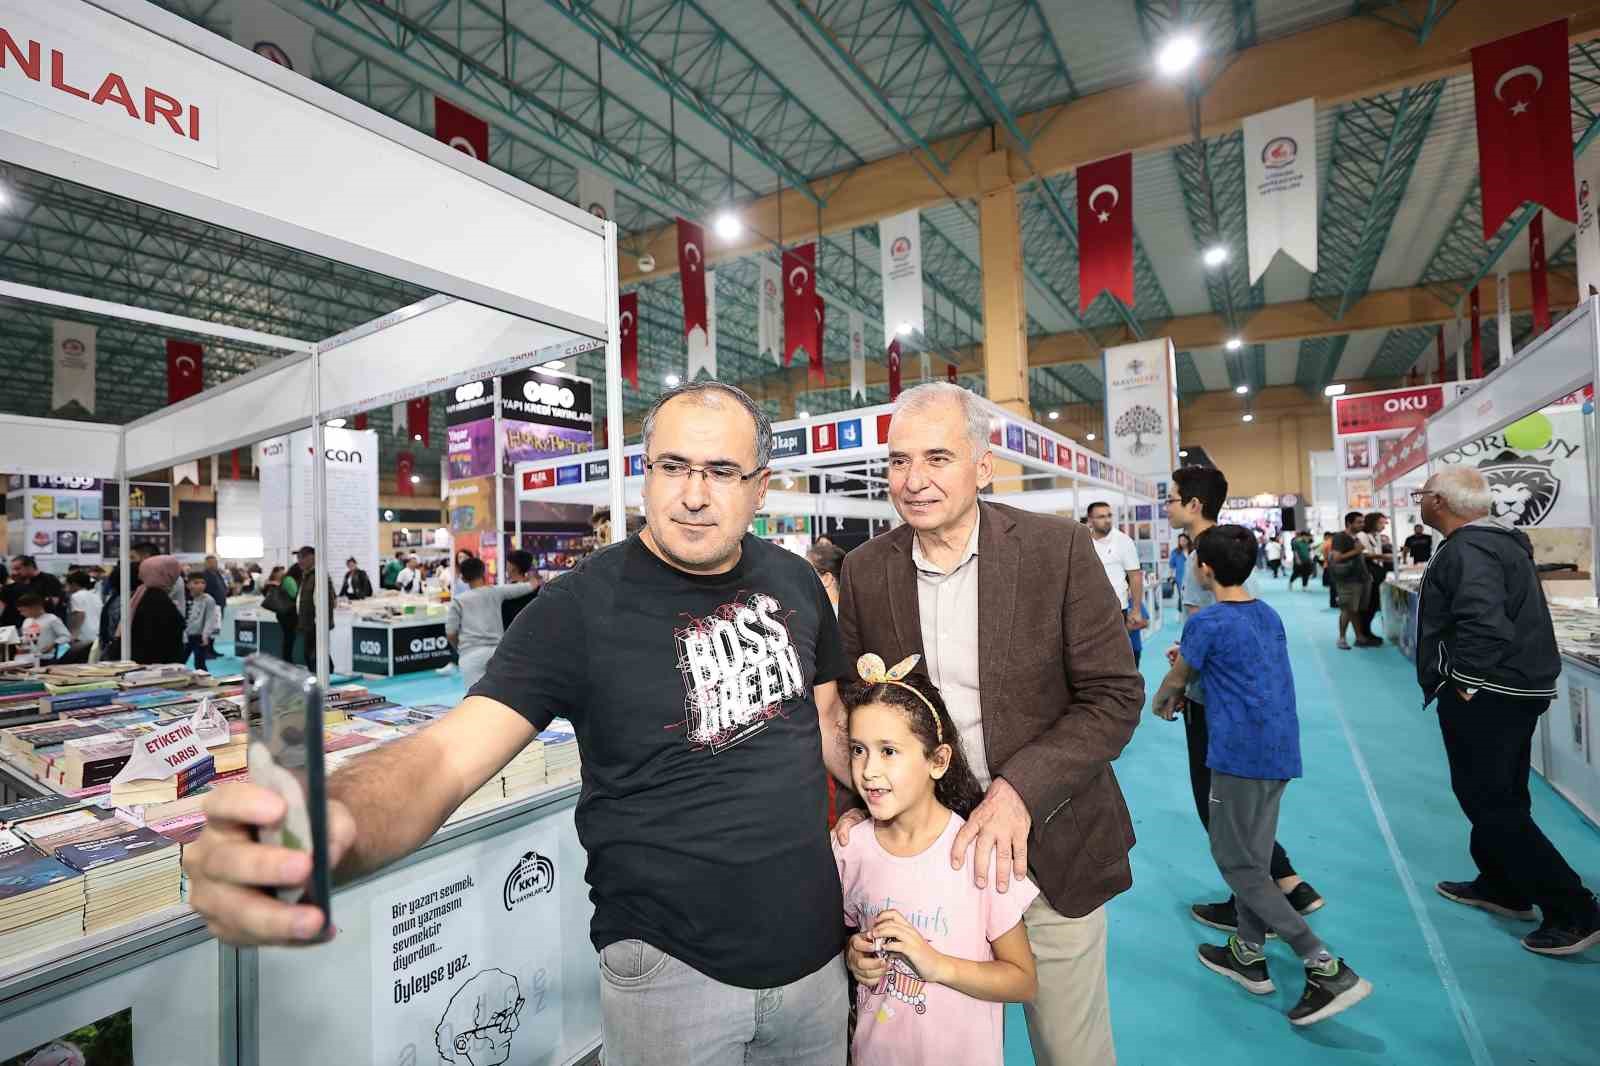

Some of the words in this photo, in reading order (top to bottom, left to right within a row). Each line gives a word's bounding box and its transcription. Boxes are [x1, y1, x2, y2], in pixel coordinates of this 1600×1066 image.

[0, 28, 200, 141] NLARI
[1384, 395, 1428, 413] OKU
[676, 593, 790, 692] BOSS
[145, 724, 194, 754] ETİKETİN
[164, 745, 200, 768] YARISI
[519, 874, 539, 892] KKM
[392, 902, 407, 919] Bir
[409, 891, 438, 915] yazarı
[392, 917, 416, 937] onun
[418, 897, 462, 928] yazmasını
[392, 922, 442, 954] sevmektir
[394, 966, 445, 1004] Öyleyse
[447, 954, 471, 980] yaz.
